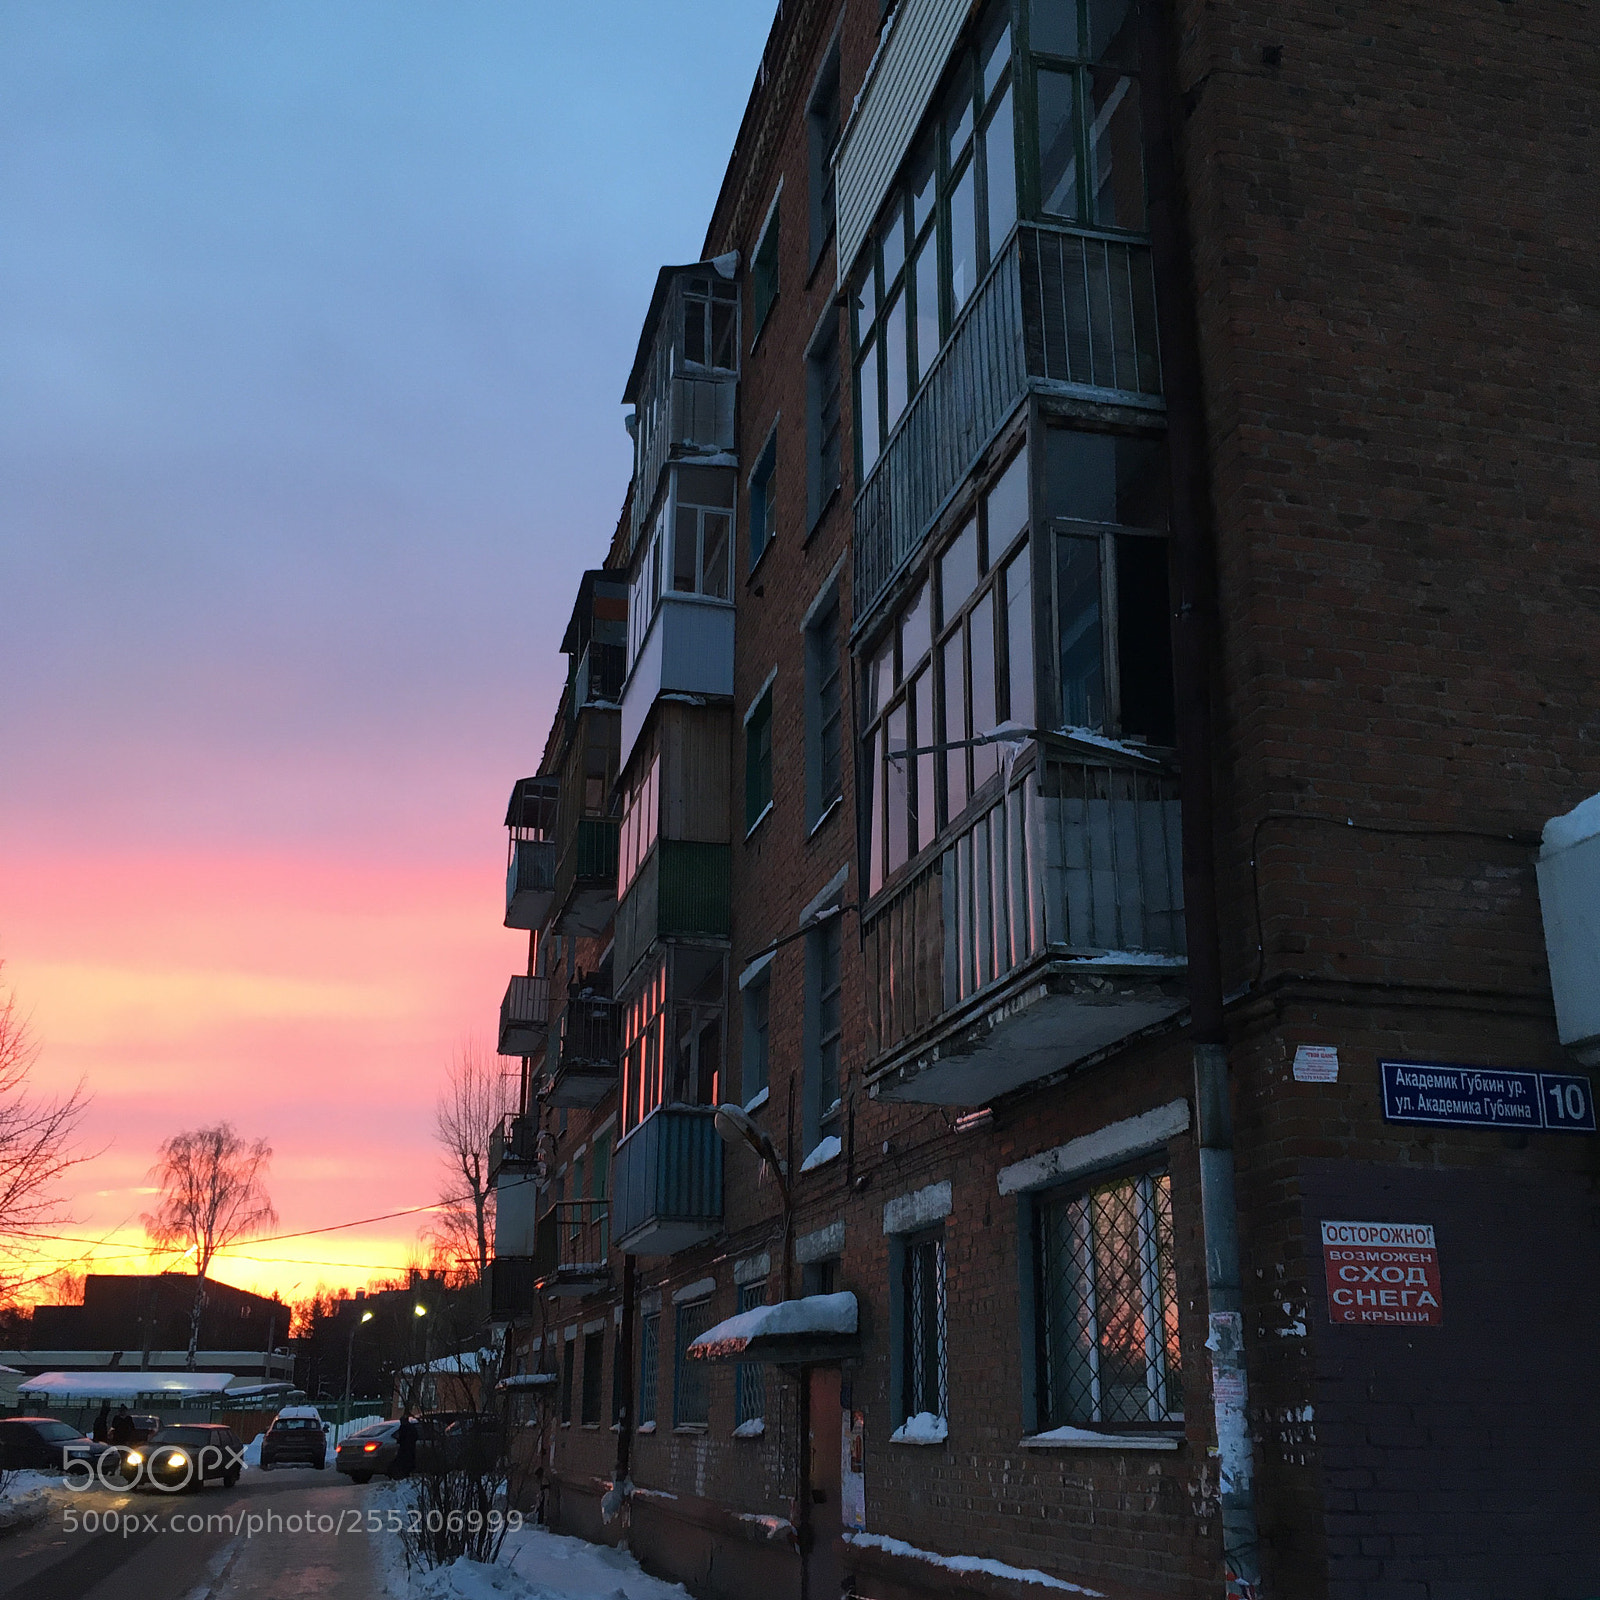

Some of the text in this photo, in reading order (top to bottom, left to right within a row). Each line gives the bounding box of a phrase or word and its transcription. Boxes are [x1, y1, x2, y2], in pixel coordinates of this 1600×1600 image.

[1395, 1069, 1526, 1097] Академик Губкин ур.
[1395, 1094, 1532, 1120] ул. Академика Губкина
[1550, 1084, 1586, 1120] 10
[1326, 1226, 1431, 1245] ОСТОРОЖНО!
[1330, 1251, 1432, 1263] ВОЗМОЖЕН
[1339, 1265, 1428, 1287] СХОД
[1333, 1289, 1439, 1308] СНЕГА
[1361, 1311, 1430, 1322] КРЫШИ
